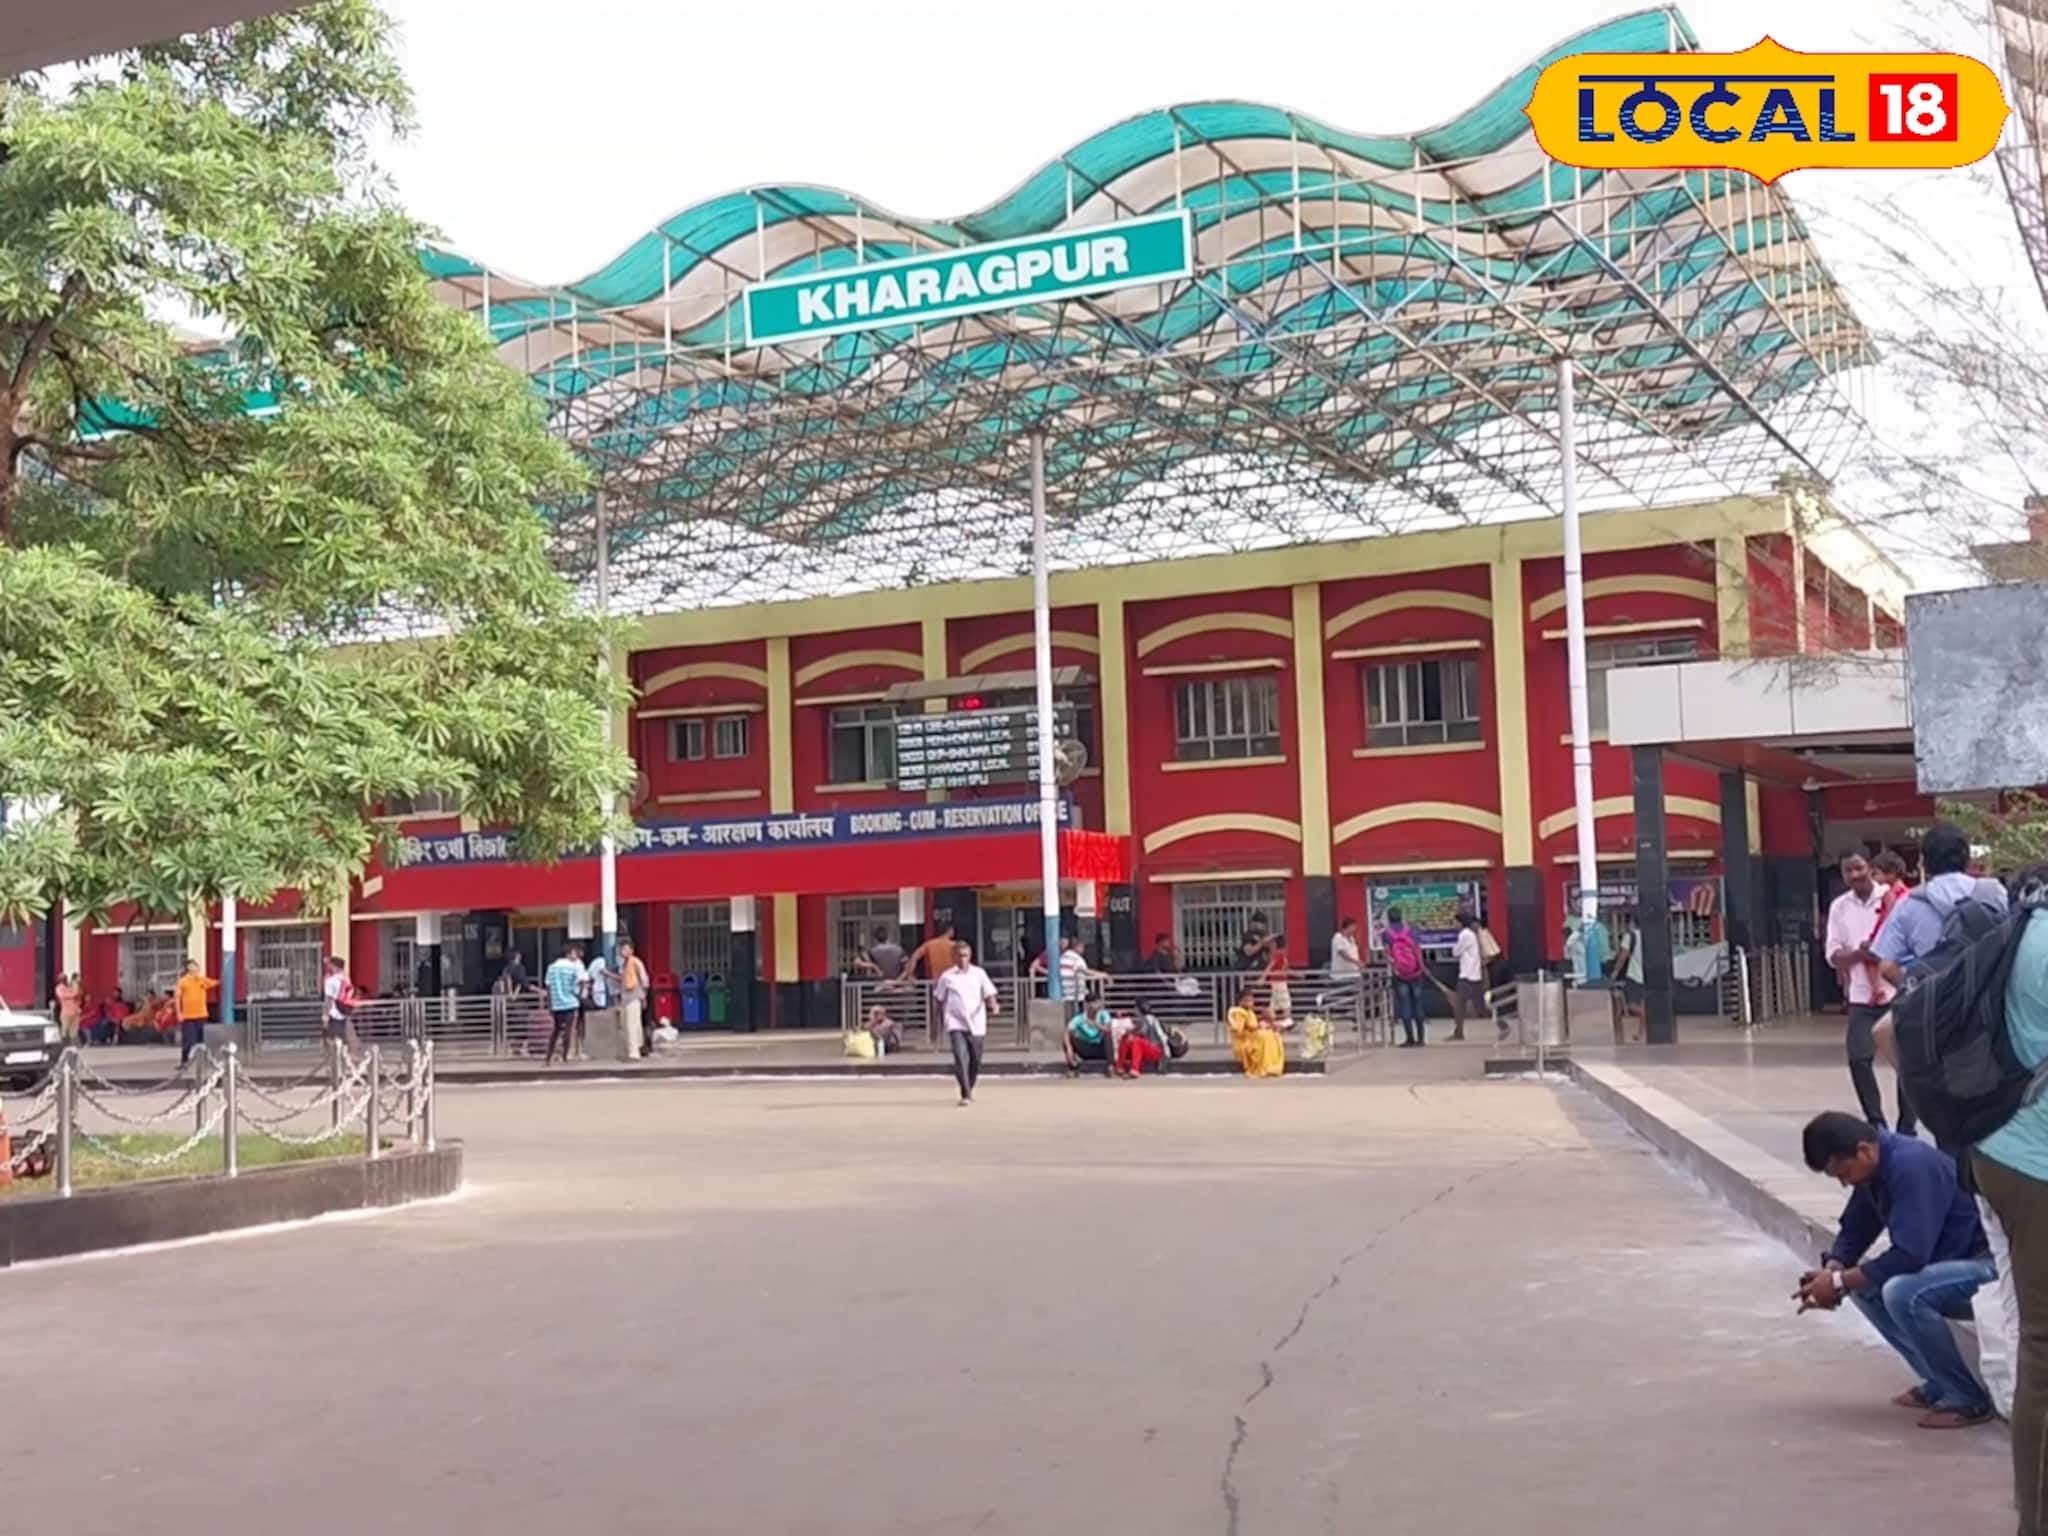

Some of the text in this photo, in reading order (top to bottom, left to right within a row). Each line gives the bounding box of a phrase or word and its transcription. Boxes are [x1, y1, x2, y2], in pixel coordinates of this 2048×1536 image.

[799, 236, 1129, 324] KHARAGPUR
[1024, 800, 1068, 823] OFE
[702, 822, 763, 844] आरक्षण
[766, 813, 834, 841] कार्यालय
